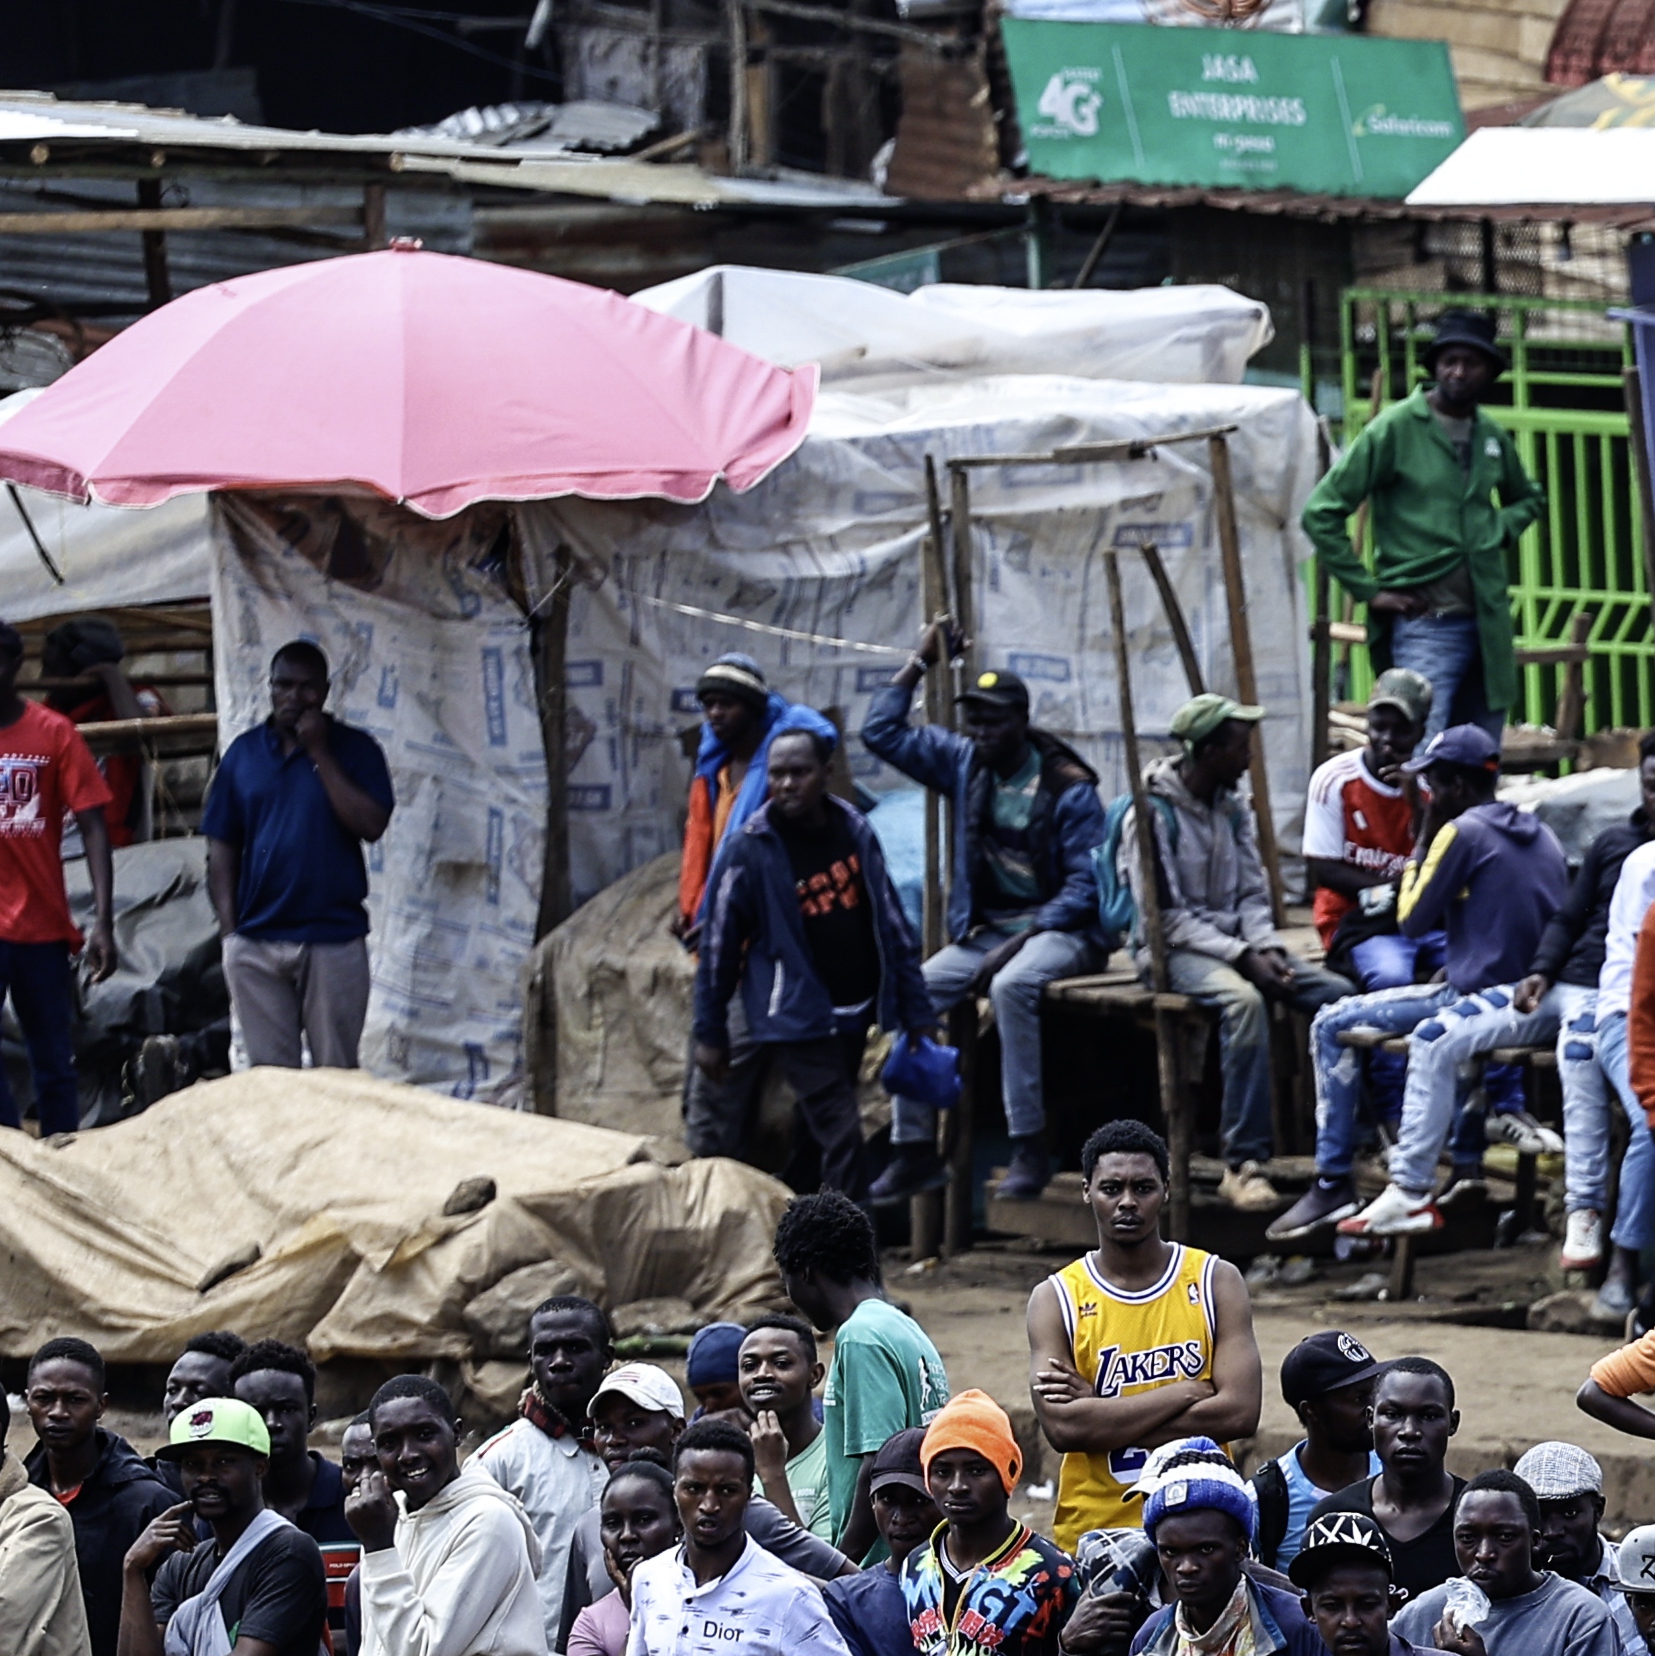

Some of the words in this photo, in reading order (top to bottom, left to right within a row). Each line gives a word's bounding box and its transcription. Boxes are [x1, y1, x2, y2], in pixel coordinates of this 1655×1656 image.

[1168, 90, 1307, 125] ENTERPRISES
[1093, 1341, 1204, 1398] LAKERS
[703, 1620, 745, 1643] Dior
